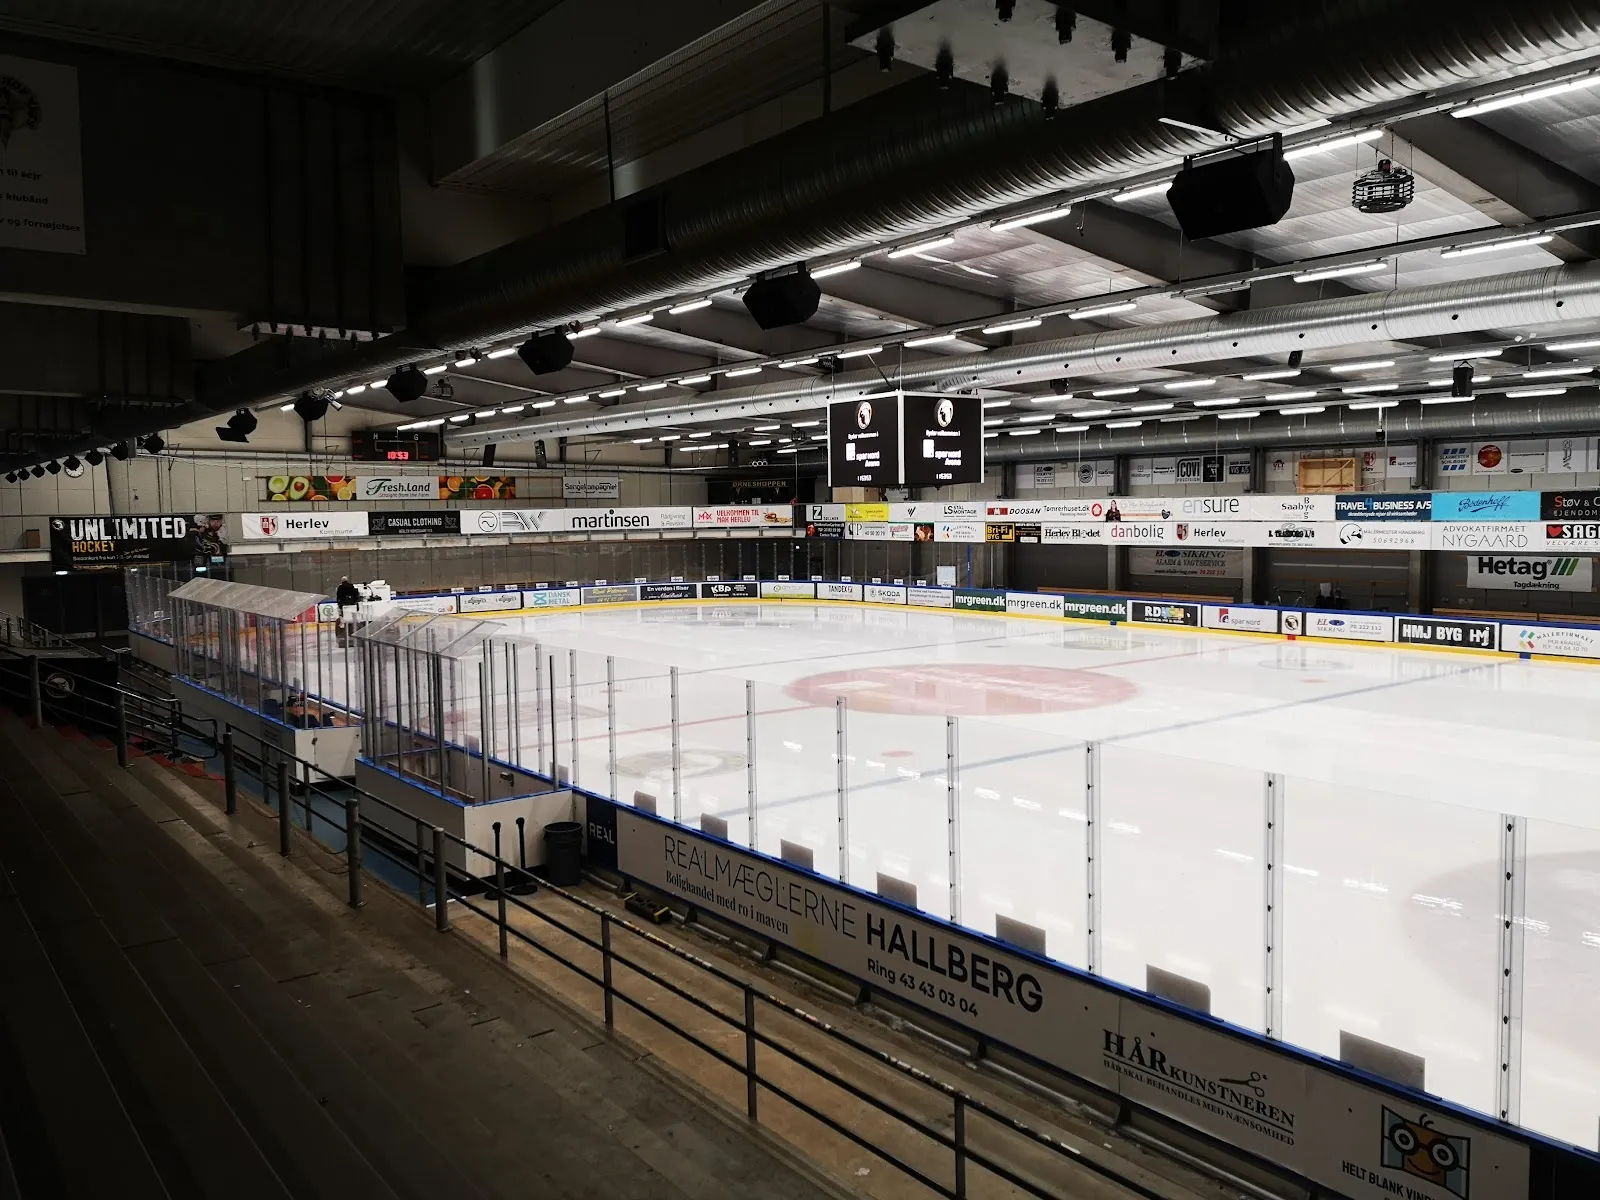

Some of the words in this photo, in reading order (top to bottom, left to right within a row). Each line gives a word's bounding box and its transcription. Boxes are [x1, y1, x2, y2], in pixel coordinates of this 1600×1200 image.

[7, 167, 17, 177] til
[21, 171, 41, 181] sejr
[6, 193, 48, 205] klubånd
[8, 218, 20, 228] og
[24, 219, 81, 233] fornøjelser
[387, 451, 409, 460] 10:53
[1182, 498, 1240, 513] ensure
[1282, 502, 1315, 511] Saabye
[1416, 501, 1432, 510] A/S
[1458, 496, 1510, 512] Bodenhoff
[1554, 496, 1580, 507] Støv
[944, 506, 953, 514] LS
[286, 518, 330, 530] Herlev
[388, 518, 412, 527] CASUAL
[412, 518, 442, 526] CLOTHING
[572, 509, 650, 528] martinsen
[70, 517, 188, 540] UNLIMITED
[988, 526, 1008, 534] Bri-Fi
[1045, 528, 1070, 537] Herlev
[1112, 524, 1164, 540] danbolig
[1194, 528, 1227, 540] Herlev
[1562, 524, 1600, 538] SAG
[72, 540, 116, 553] HOCKEY
[1442, 534, 1528, 548] NYGAARD
[1182, 550, 1226, 558] SIKRING
[1514, 581, 1560, 590] Tagdækning
[955, 594, 1006, 606] mrgreen.dk
[1007, 598, 1062, 610] mrgreen.dk
[1064, 601, 1126, 615] mrgreen.dk
[1316, 618, 1328, 626] EL
[1402, 624, 1432, 640] HMJ
[1436, 626, 1463, 642] BYG
[1536, 632, 1594, 644] MALERFIRMAET
[589, 822, 615, 845] REAL
[664, 834, 857, 939] REALMÆGLERNE
[666, 869, 714, 907] Bolighandel
[716, 892, 736, 911] med
[738, 903, 749, 917] ro
[756, 912, 788, 941] maven
[866, 911, 1043, 1017] HALLBERG
[867, 958, 896, 984] Ring
[899, 972, 915, 993] 43
[918, 980, 935, 1002] 43
[939, 988, 956, 1010] 03
[959, 998, 978, 1017] 04
[1103, 1059, 1122, 1074] HÅR
[1123, 1065, 1145, 1083] SKAL
[1146, 1074, 1201, 1107] BEHANDLES
[1202, 1100, 1224, 1117] MED
[1225, 1110, 1295, 1147] NÆNSOMHED
[1342, 1160, 1367, 1181] HELT
[1369, 1172, 1404, 1198] BLANK
